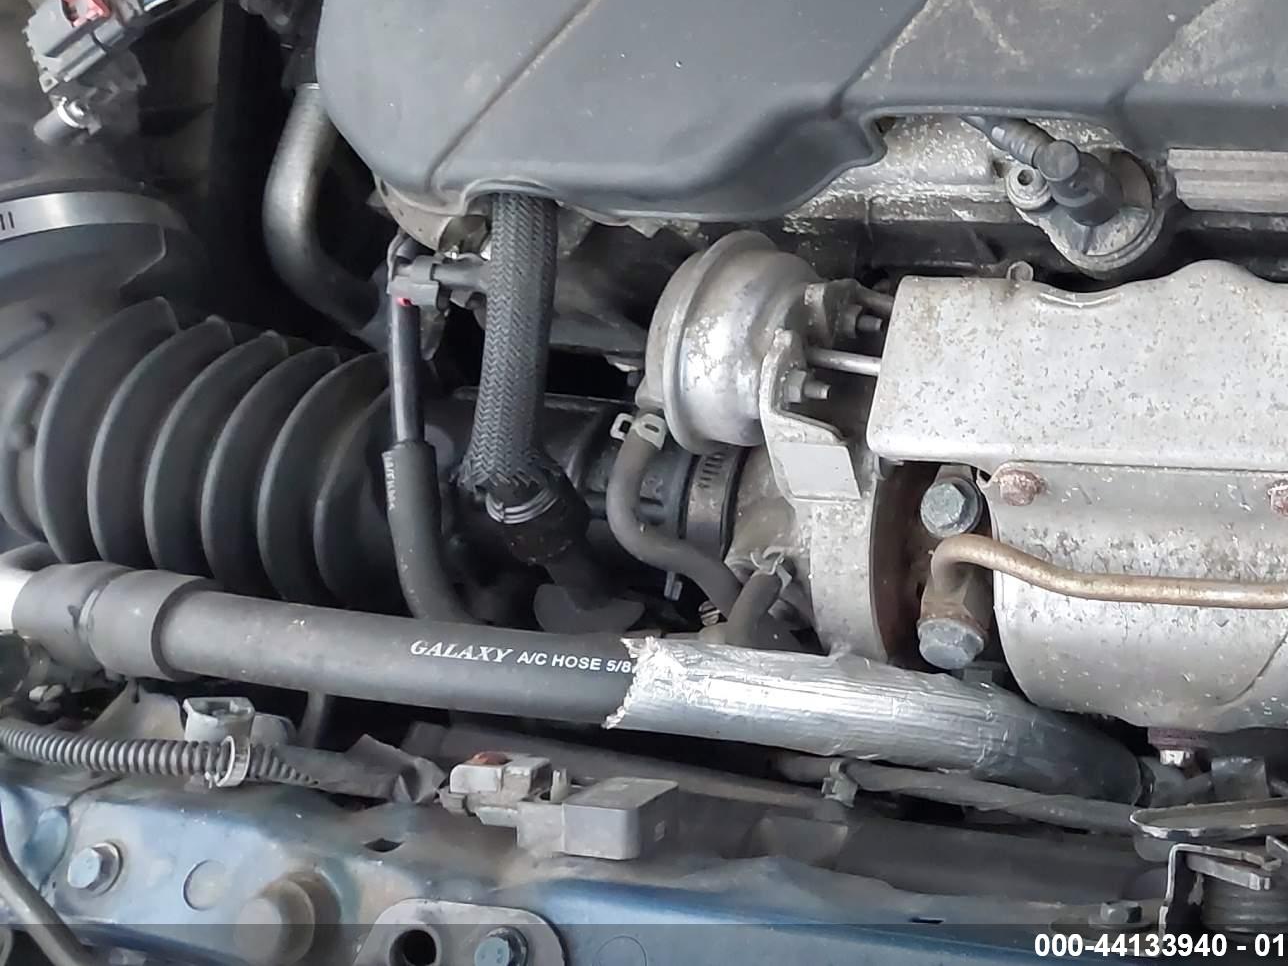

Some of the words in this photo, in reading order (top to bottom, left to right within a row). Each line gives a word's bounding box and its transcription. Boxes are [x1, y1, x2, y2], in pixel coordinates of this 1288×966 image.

[409, 639, 514, 663] GALAXY
[516, 651, 548, 666] A/C
[551, 654, 602, 671] HOSE
